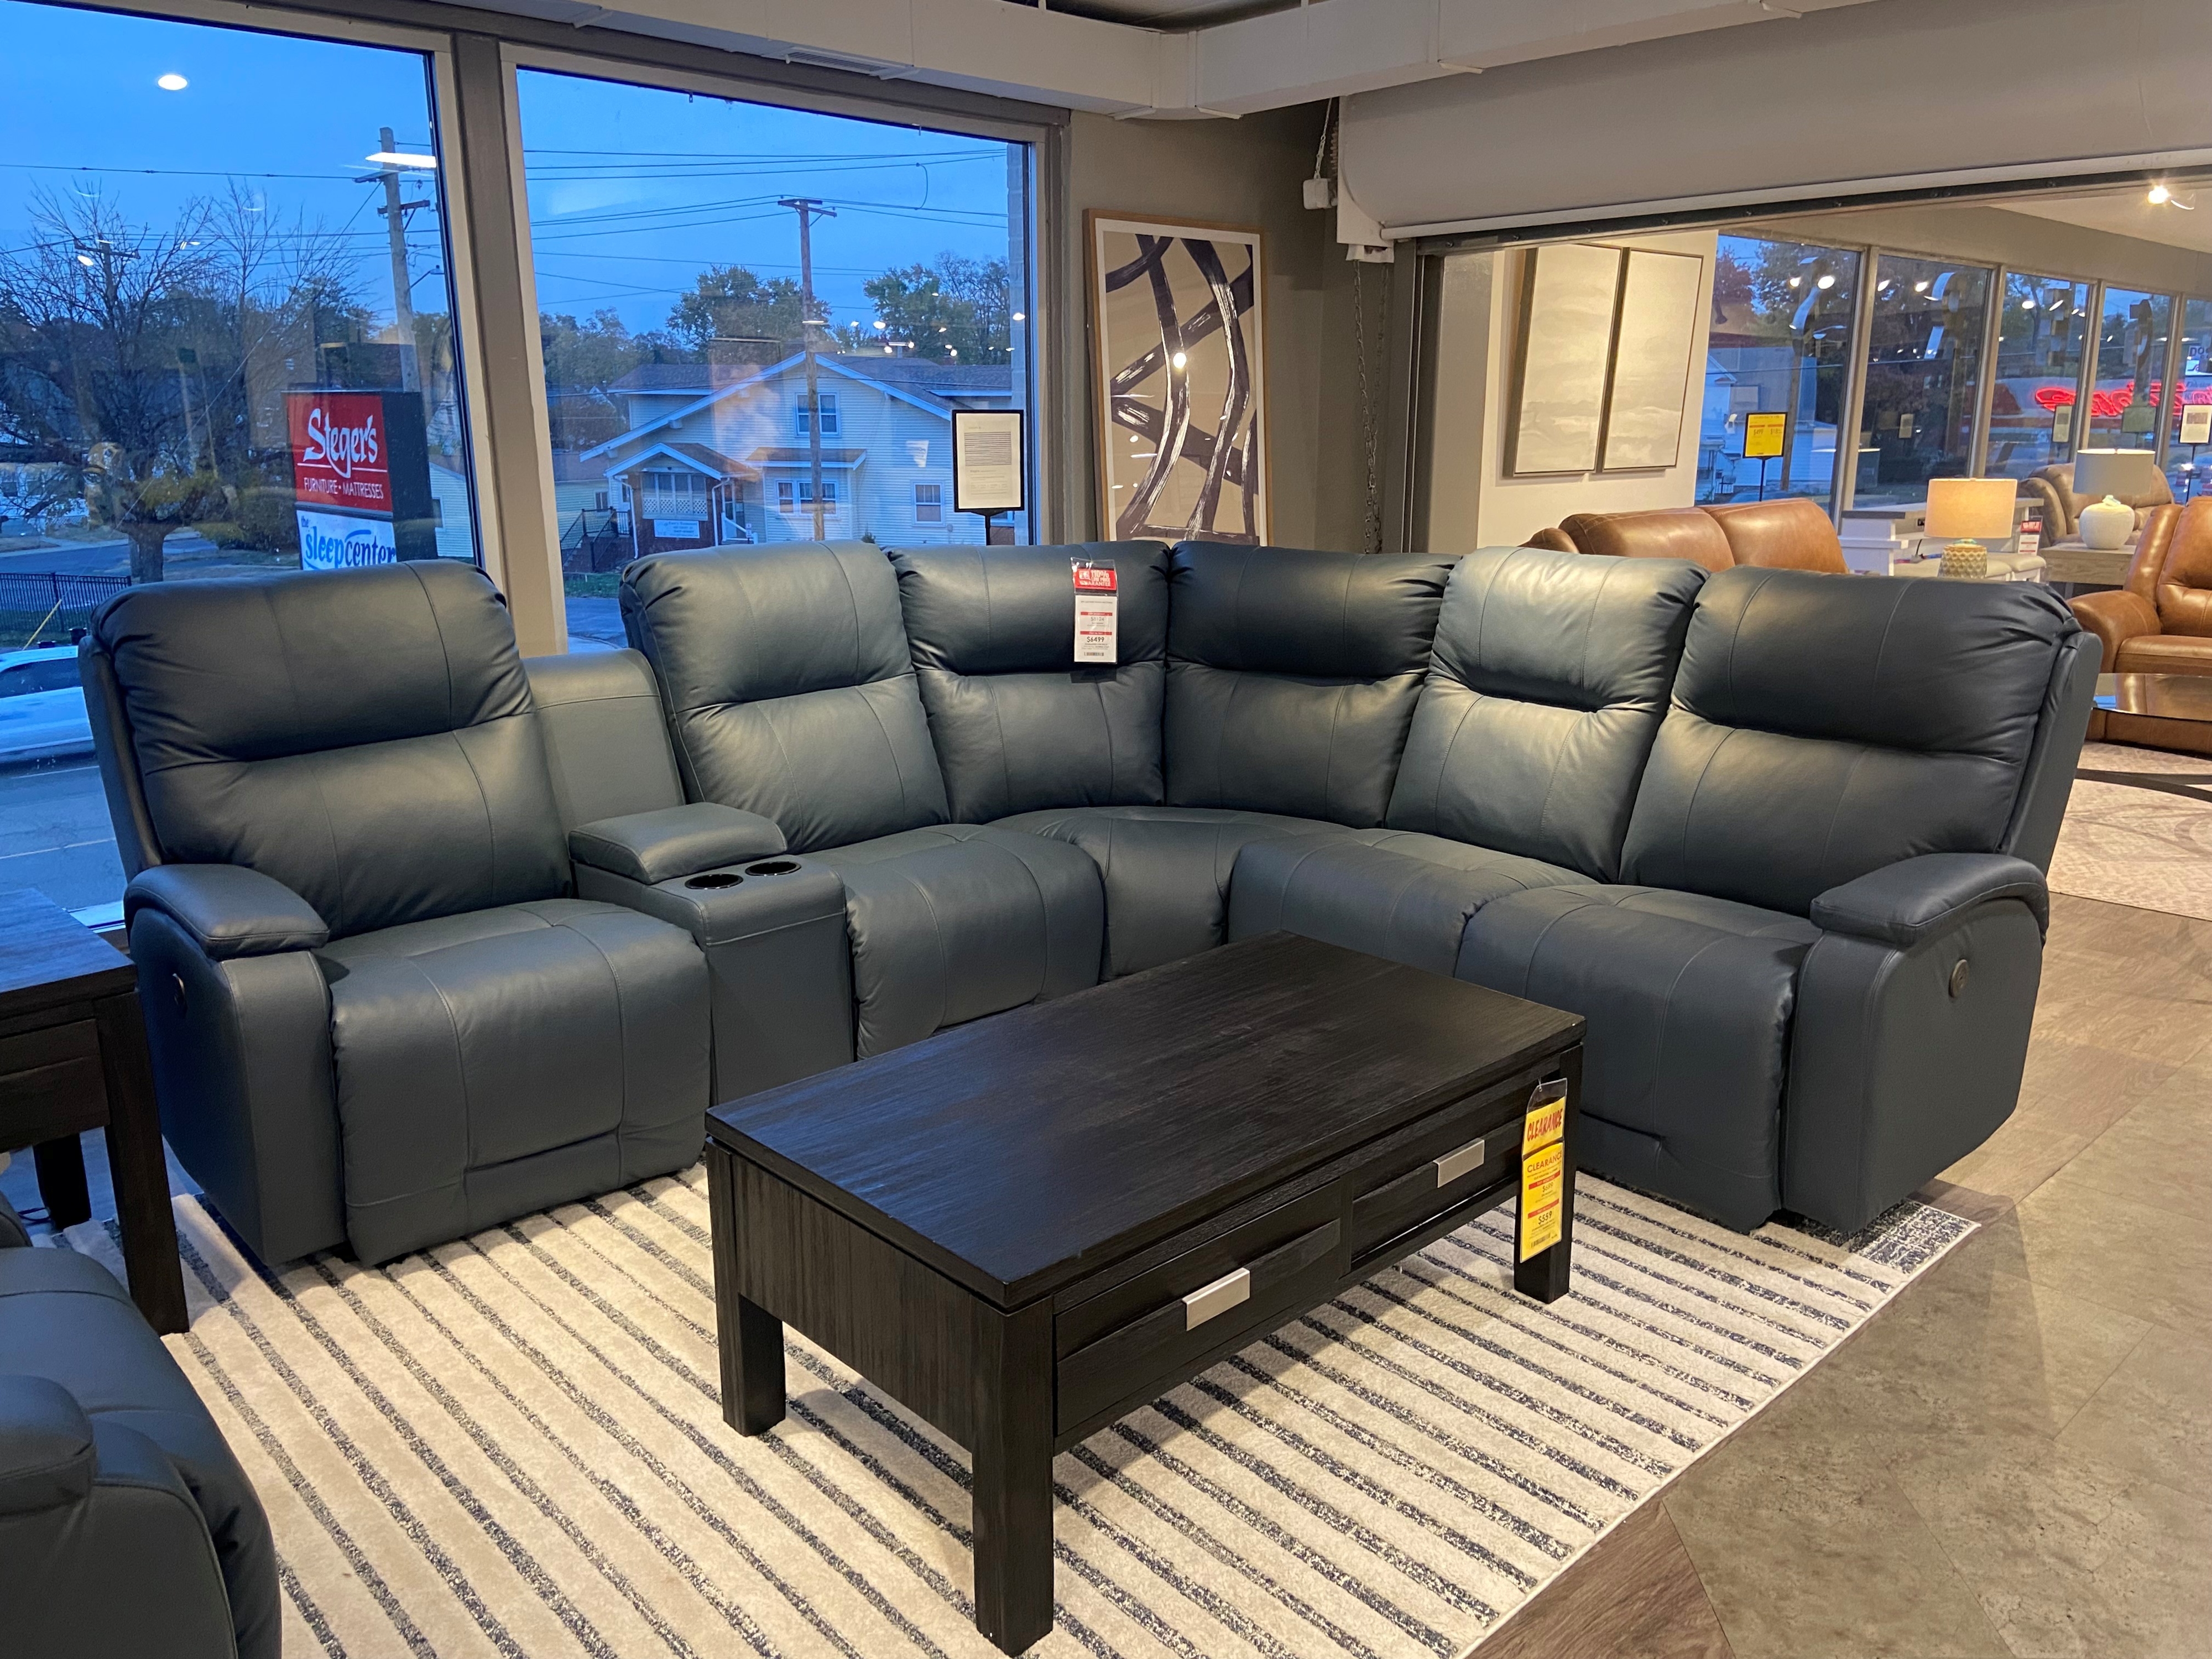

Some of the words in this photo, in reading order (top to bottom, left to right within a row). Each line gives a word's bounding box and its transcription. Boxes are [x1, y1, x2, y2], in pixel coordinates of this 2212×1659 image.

[303, 408, 378, 478] Steger's
[304, 477, 338, 494] FURNITURE
[342, 482, 384, 499] MATTRESSES
[1527, 1108, 1563, 1142] CLEARANCE
[1527, 1151, 1562, 1173] CLEARANCE
[1538, 1211, 1553, 1225] $559
